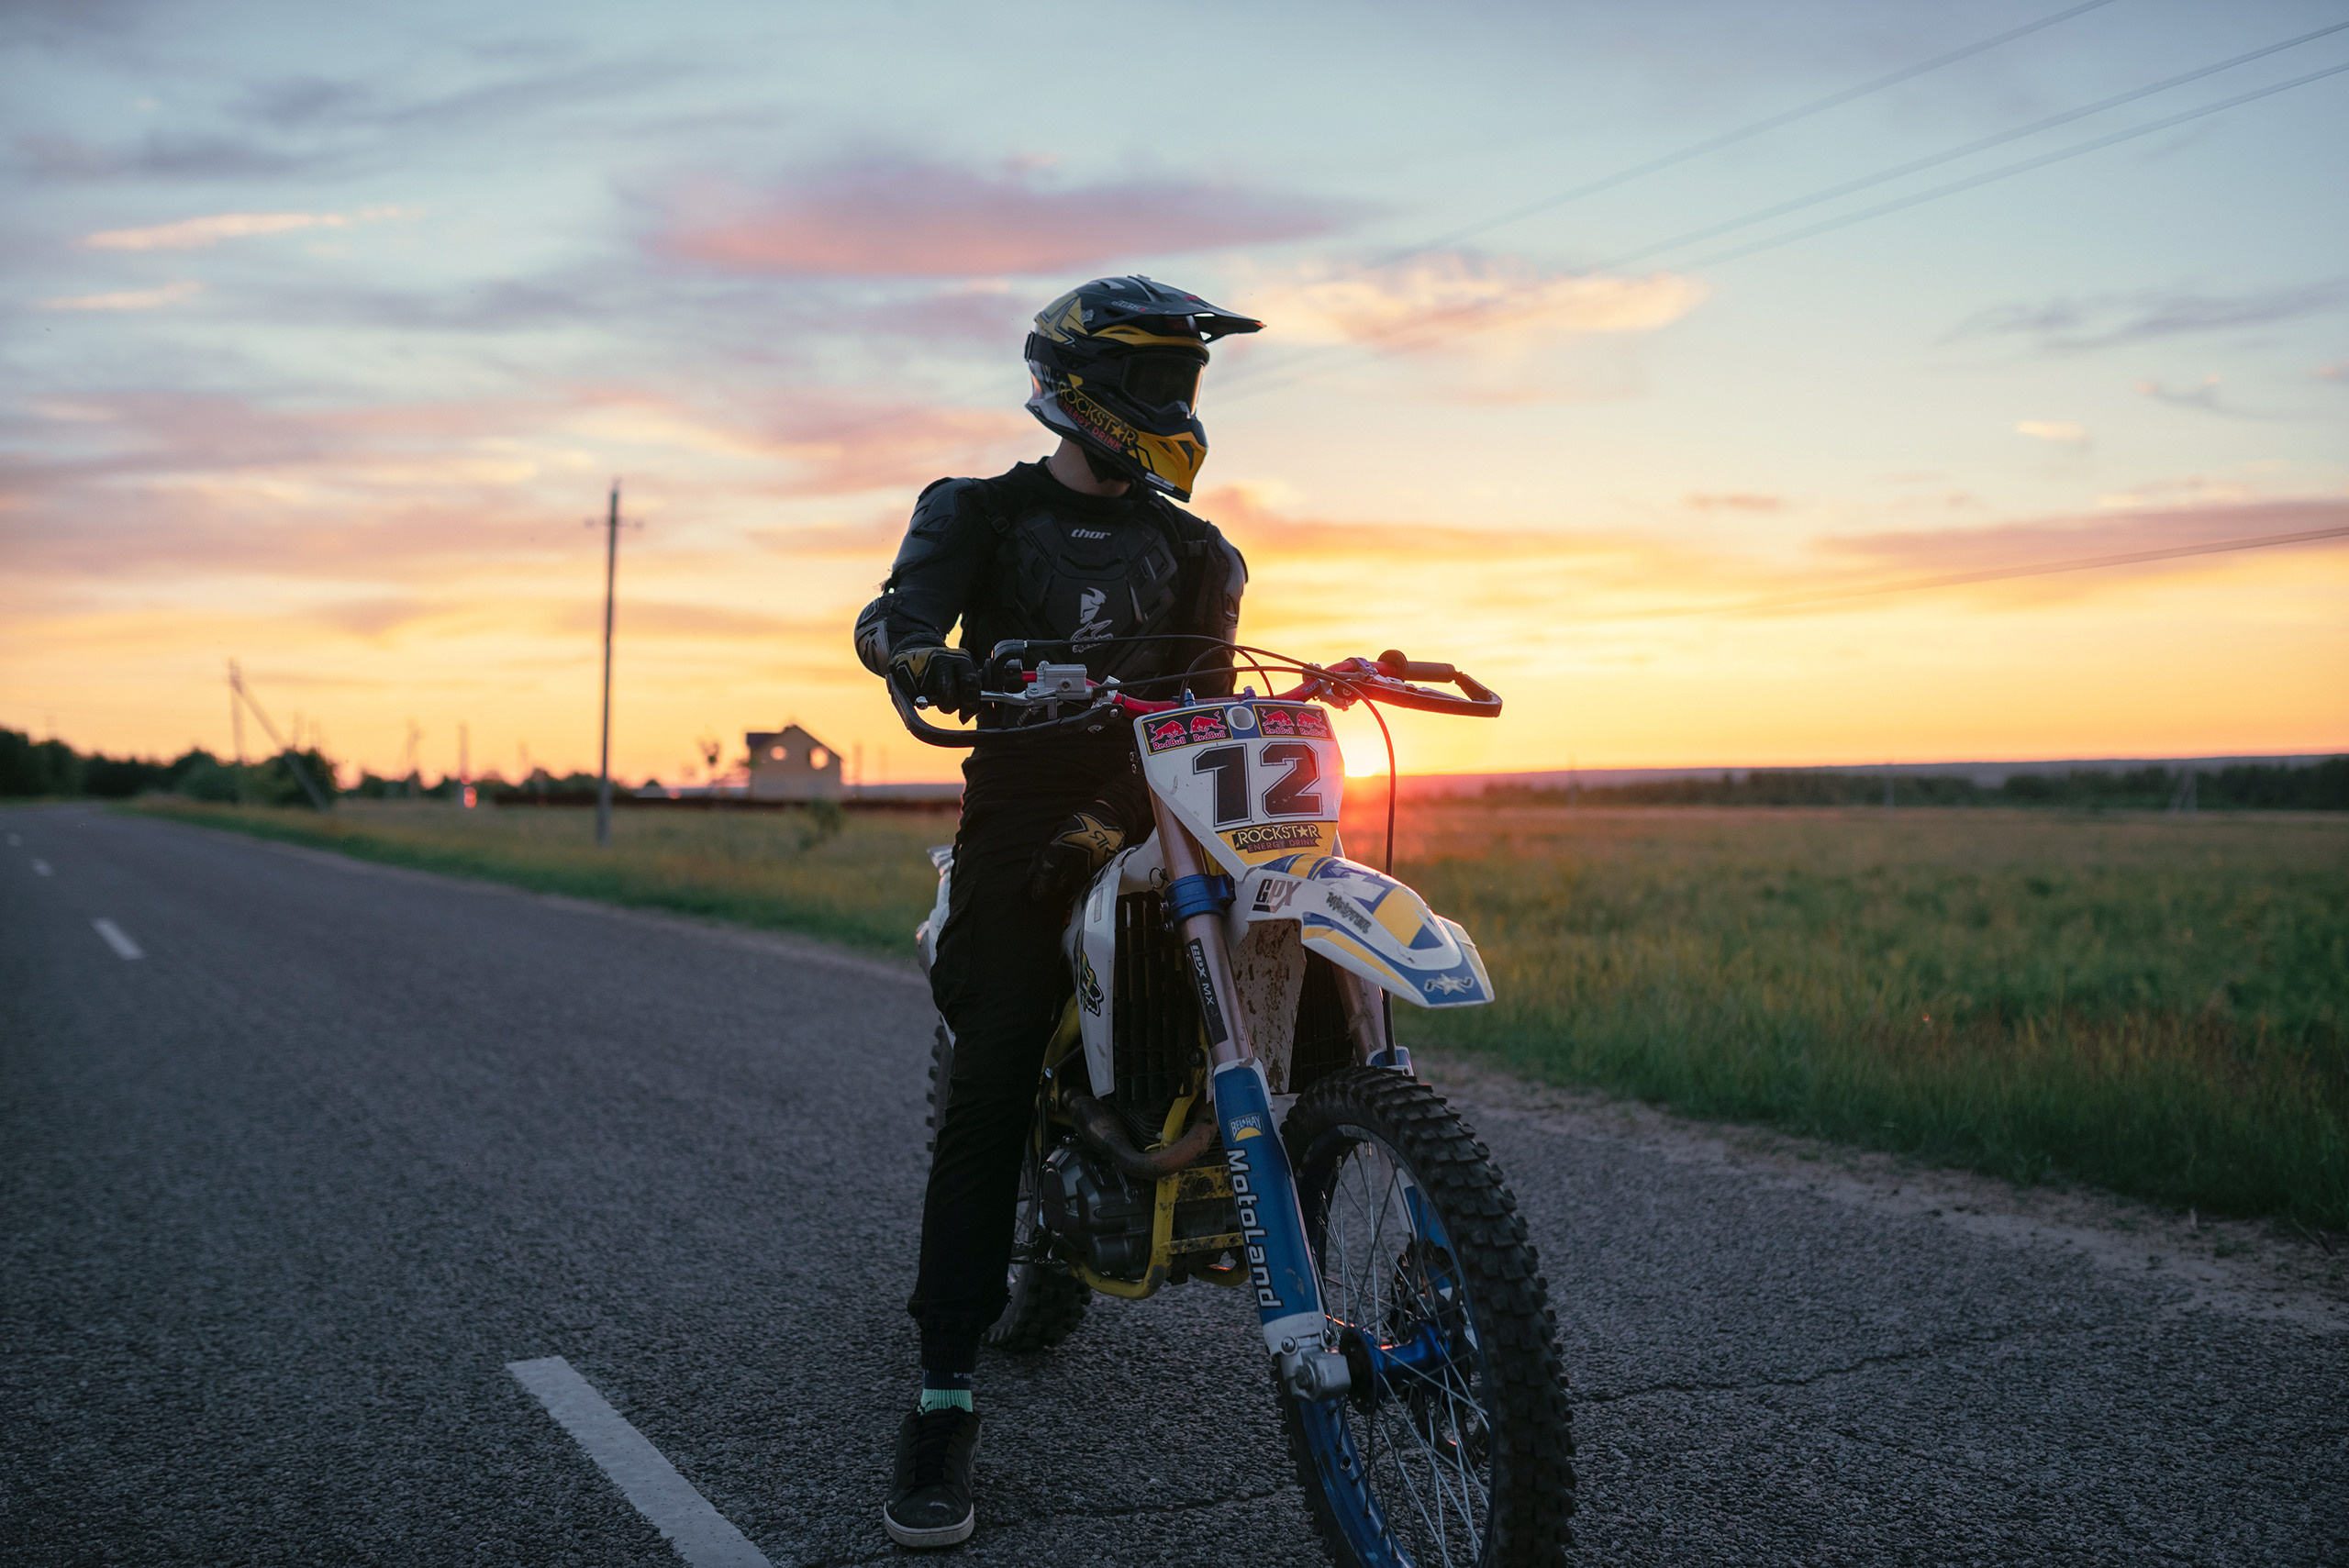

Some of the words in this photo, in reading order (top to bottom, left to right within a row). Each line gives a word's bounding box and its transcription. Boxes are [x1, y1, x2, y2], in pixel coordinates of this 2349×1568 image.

[1057, 397, 1090, 428] ENERGY
[1091, 426, 1121, 450] DRINK
[1070, 528, 1111, 539] thor
[1193, 732, 1208, 741] Red
[1209, 729, 1225, 739] Bull
[1264, 726, 1278, 734] Red
[1298, 727, 1312, 735] Red
[1152, 741, 1169, 750] Red
[1169, 736, 1186, 746] Bull
[1193, 741, 1322, 827] 12
[1247, 840, 1285, 852] ENERGY
[1288, 837, 1316, 846] DRINK
[1252, 877, 1302, 912] GPX
[1202, 983, 1215, 1006] MX
